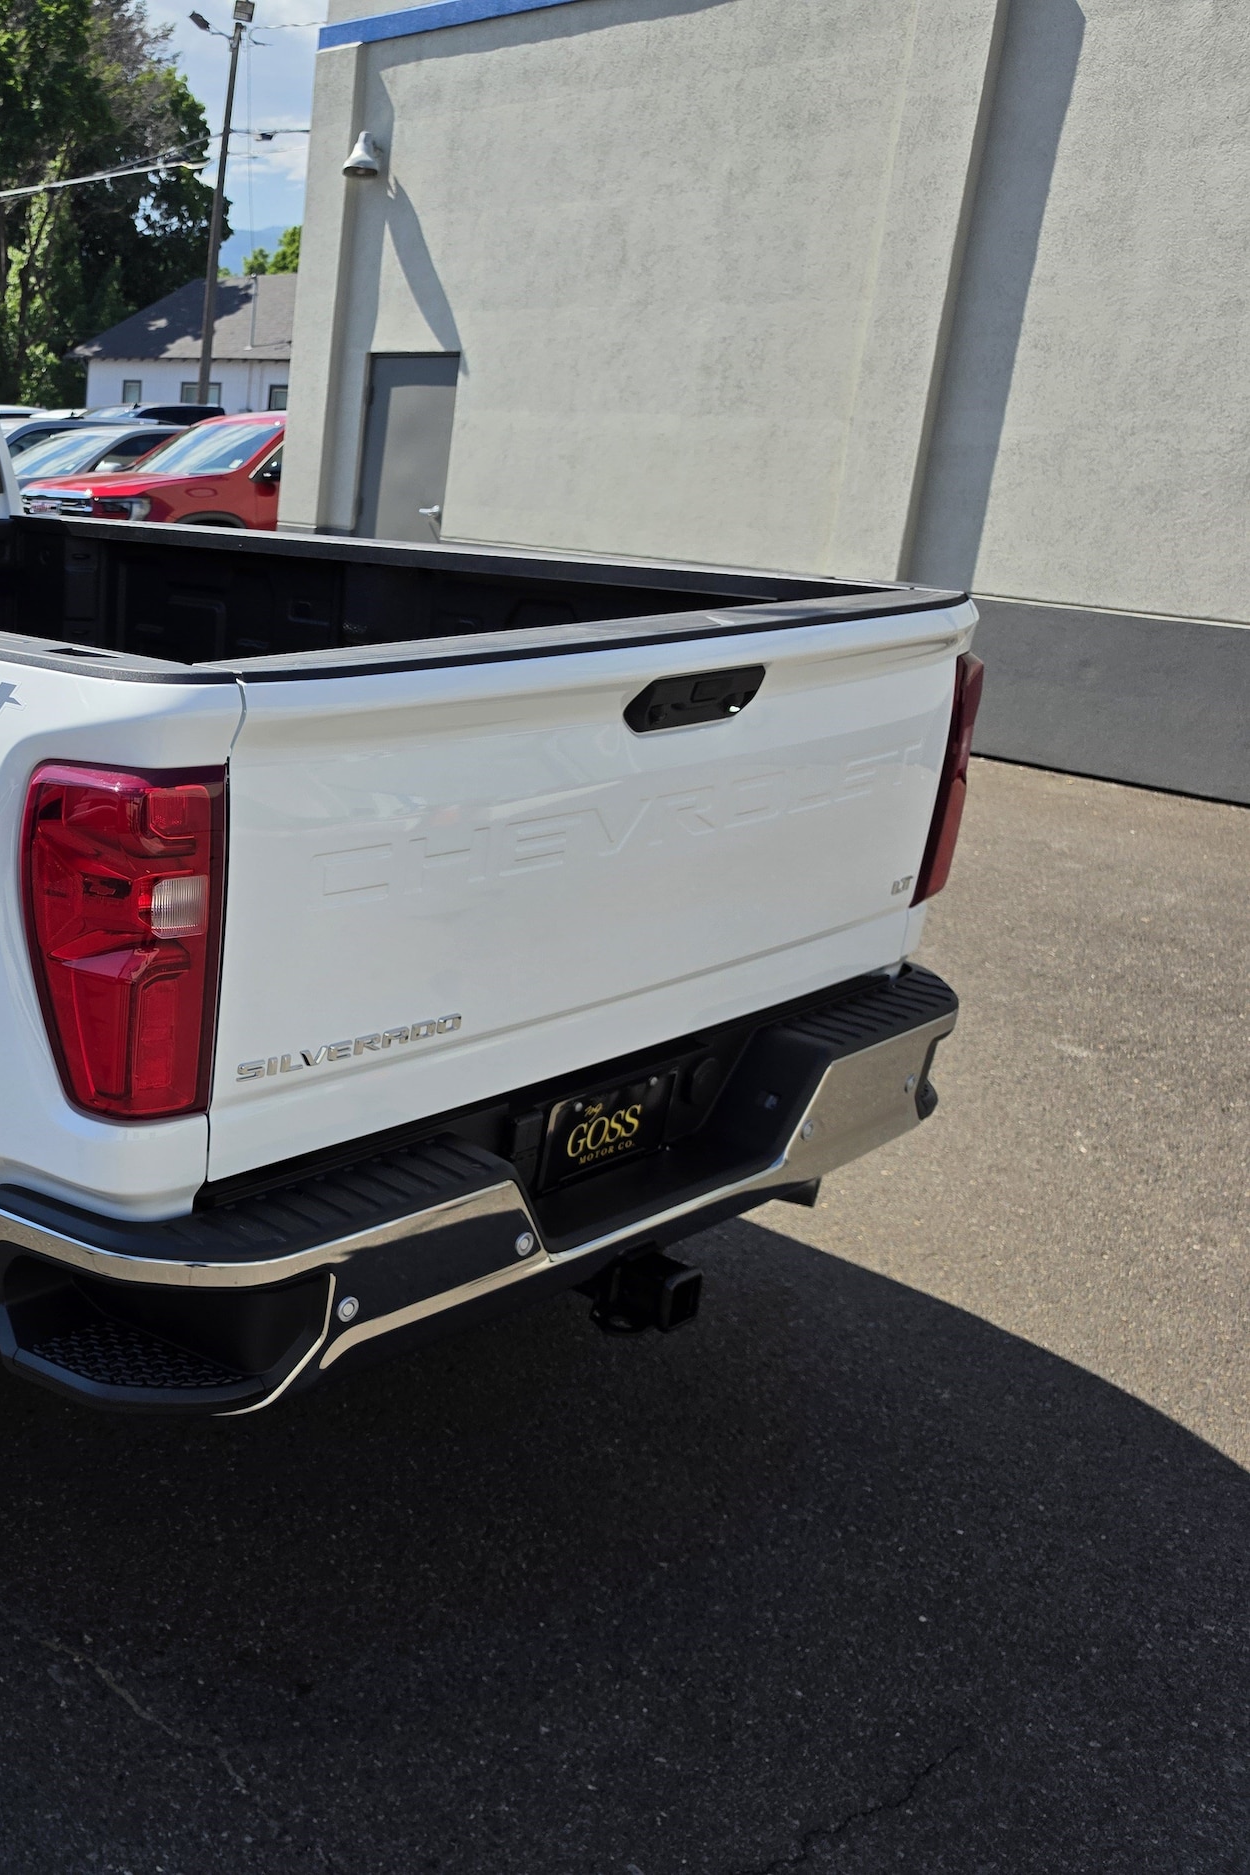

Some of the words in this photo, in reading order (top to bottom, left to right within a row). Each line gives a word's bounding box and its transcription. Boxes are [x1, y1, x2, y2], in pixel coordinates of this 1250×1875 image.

[309, 740, 926, 909] CHEVROLET
[890, 875, 914, 896] LT
[236, 1012, 462, 1083] SILVERADO
[566, 1103, 642, 1158] GOSS
[579, 1146, 614, 1165] MOTOR
